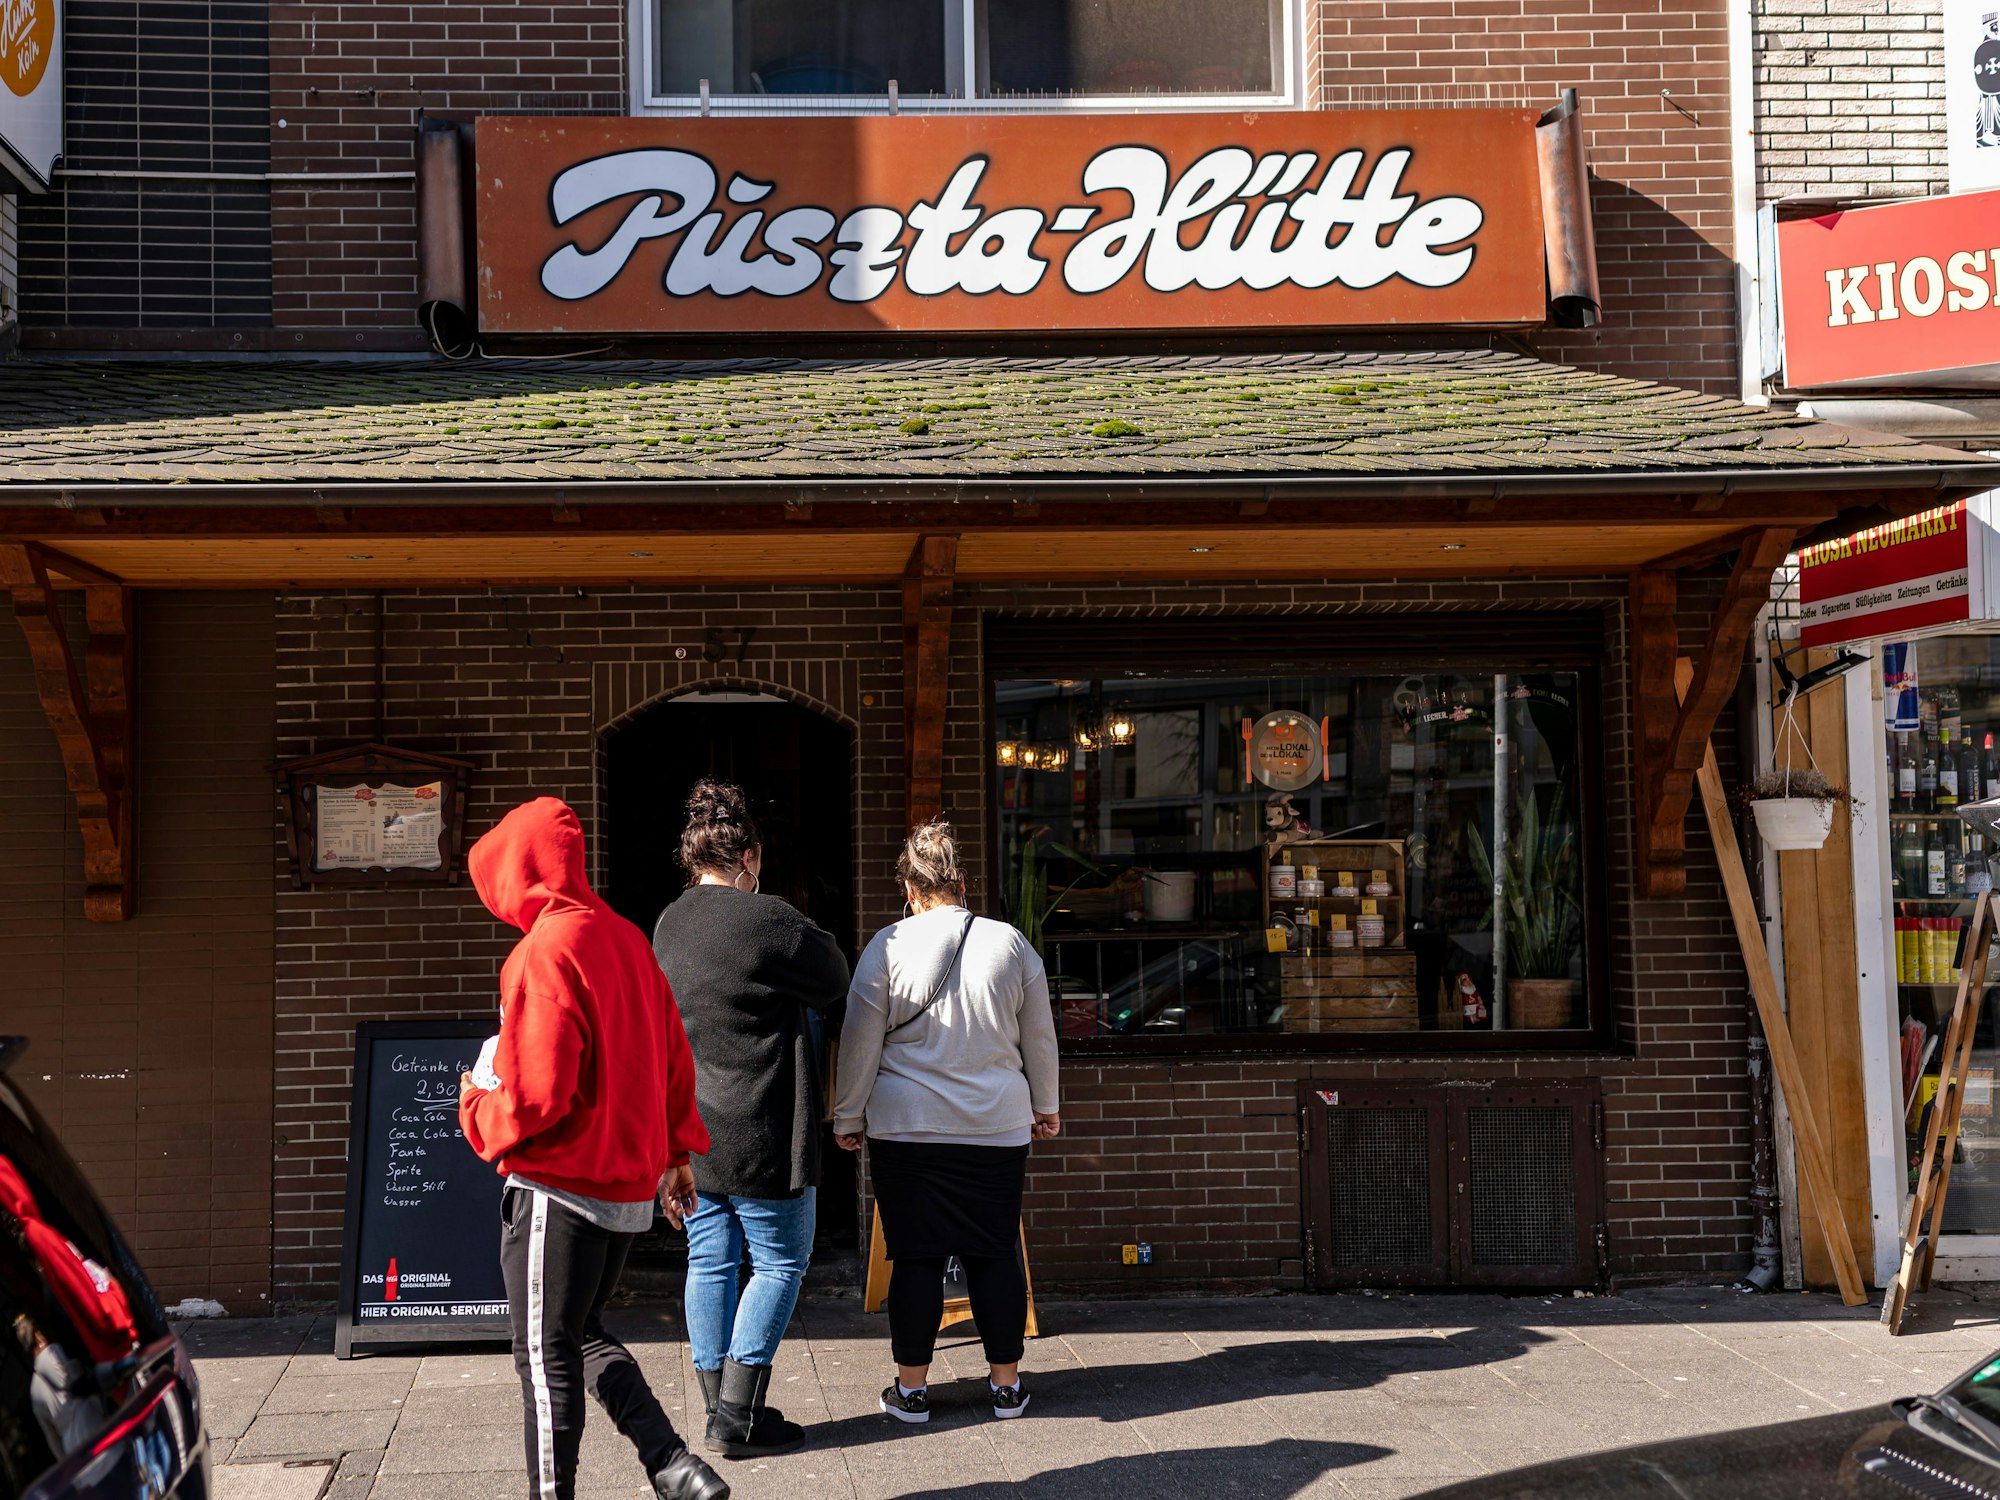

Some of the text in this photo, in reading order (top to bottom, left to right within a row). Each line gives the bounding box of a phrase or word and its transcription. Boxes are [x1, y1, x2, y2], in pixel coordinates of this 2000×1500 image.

[17, 36, 40, 80] Köln
[1825, 247, 2000, 328] KIOS
[1856, 500, 1961, 555] NEUMARKT
[1821, 601, 1851, 617] Zigaretten
[1855, 592, 1893, 608] Süßigkeiten
[1897, 584, 1931, 600] Zeitungen
[1936, 575, 1968, 591] Getränke
[1273, 750, 1305, 759] LOKAL
[1280, 743, 1311, 752] LOKAL
[391, 1054, 470, 1073] Getränke to
[391, 1107, 447, 1123] Coca Cola
[388, 1127, 419, 1140] Coca
[422, 1127, 450, 1140] Cola
[389, 1142, 427, 1158] Fanta
[385, 1162, 422, 1181] Sprite
[421, 1181, 447, 1193] Still
[362, 1274, 384, 1284] DAS
[400, 1272, 451, 1284] ORIGINAL
[360, 1303, 510, 1318] HIER ORIGINAL SERVIERT!
